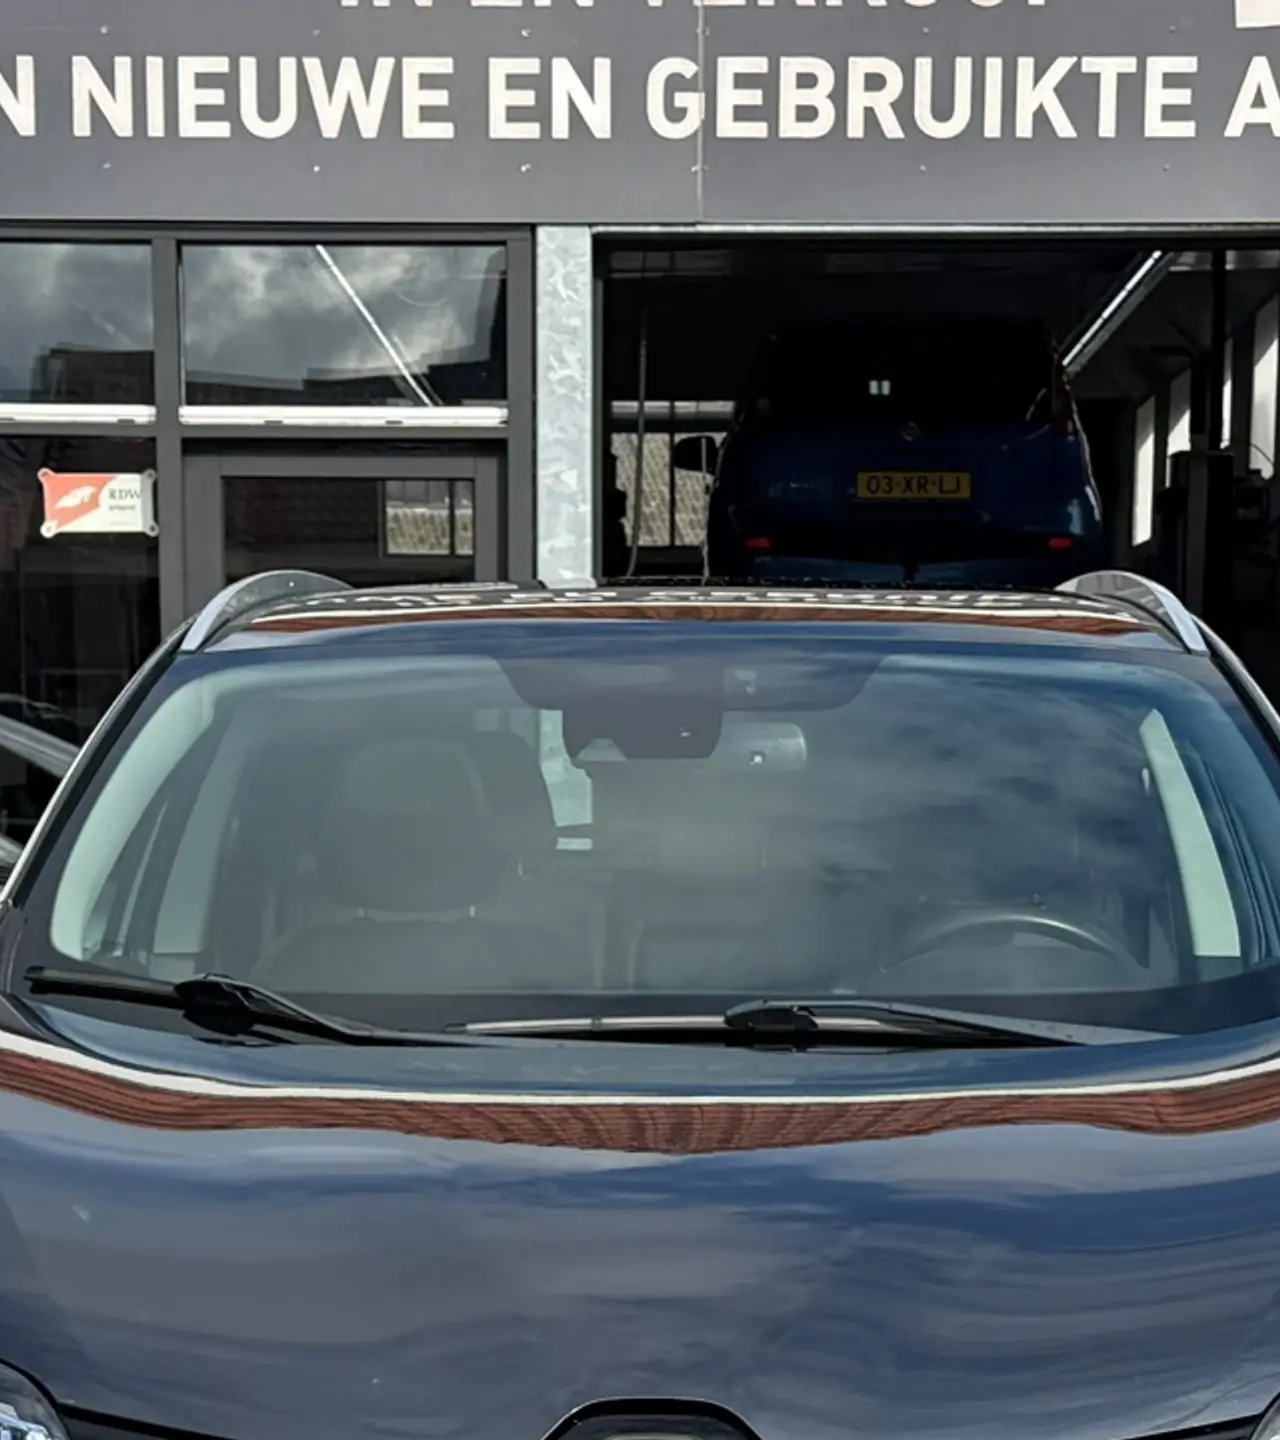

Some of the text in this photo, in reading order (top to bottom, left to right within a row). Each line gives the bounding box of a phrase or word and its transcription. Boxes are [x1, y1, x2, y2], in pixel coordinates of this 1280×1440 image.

[71, 55, 455, 139] NIEUWE
[488, 57, 612, 139] EN
[646, 55, 1198, 140] GEBRUIKTE
[866, 475, 961, 495] 03-XR-LJ
